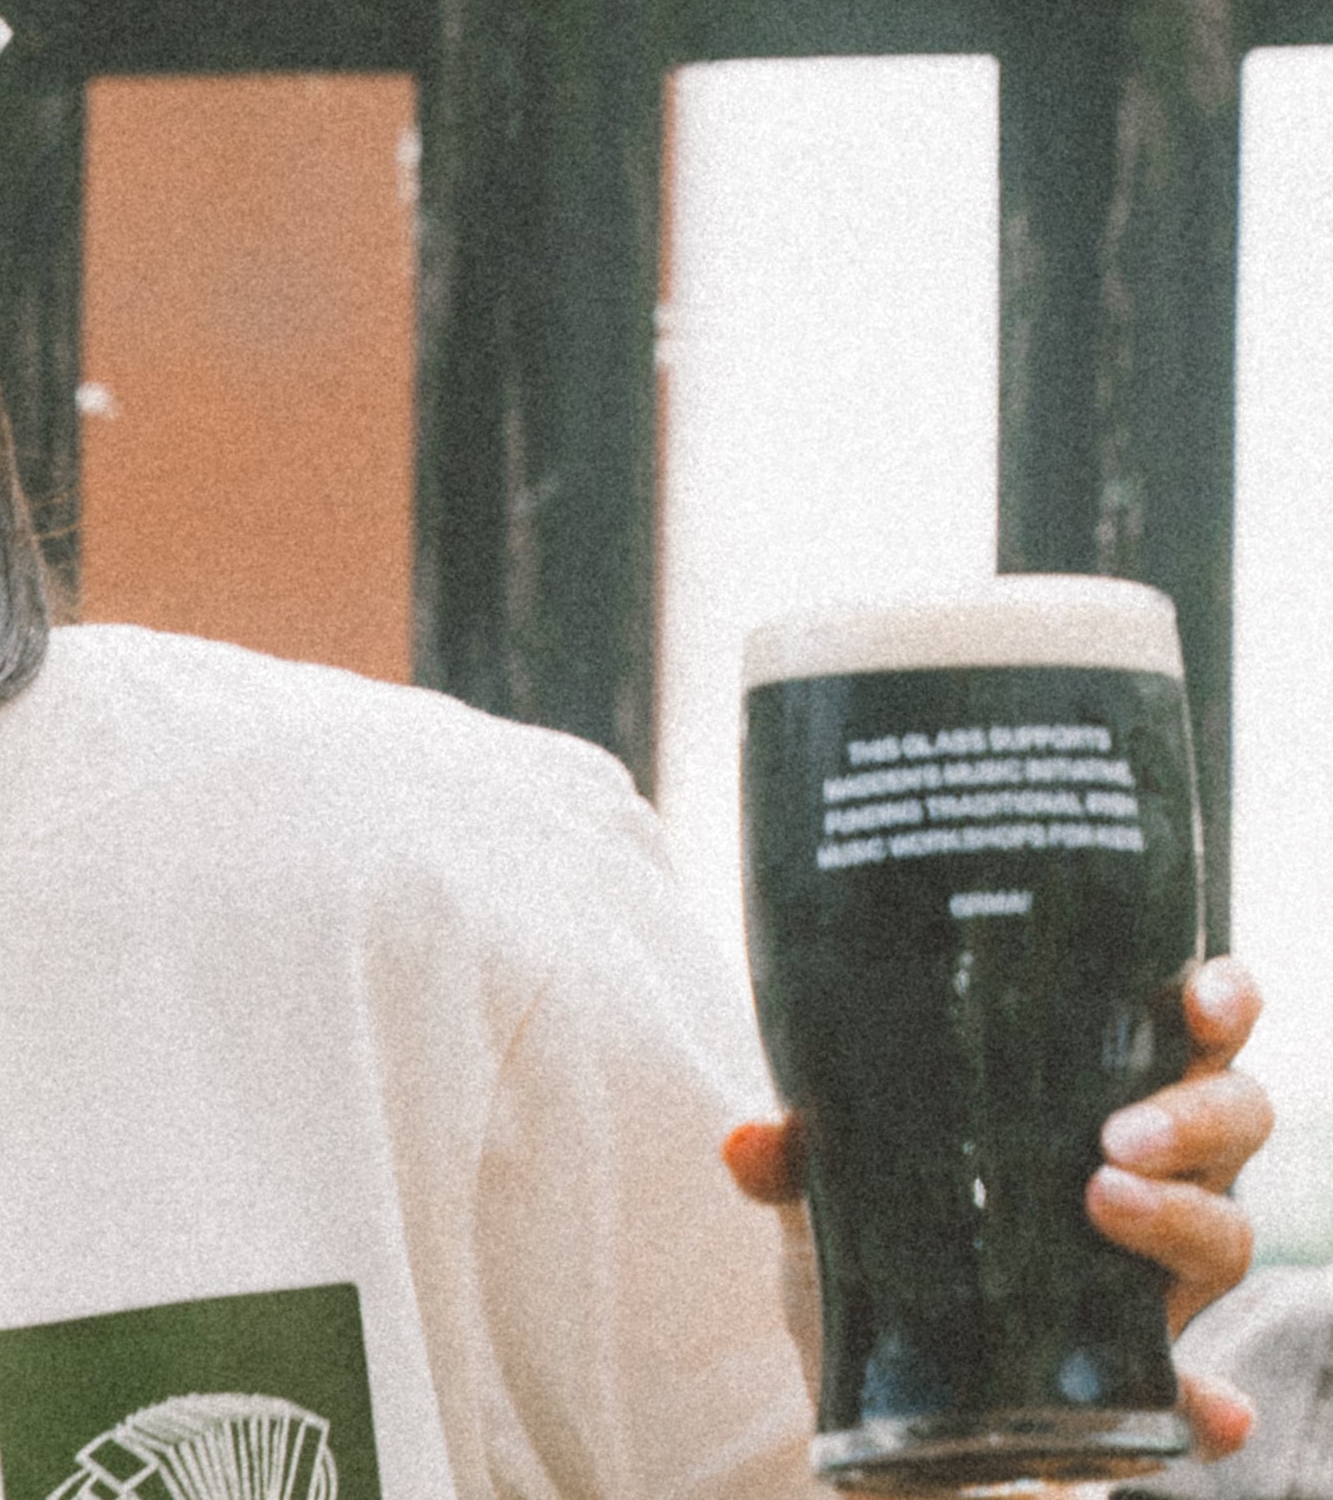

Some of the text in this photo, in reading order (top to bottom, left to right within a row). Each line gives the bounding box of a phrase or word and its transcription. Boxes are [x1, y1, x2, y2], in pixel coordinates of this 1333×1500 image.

[901, 726, 987, 760] GLASS
[988, 723, 1113, 753] SUPPORTS
[943, 758, 1023, 787] MUSIC
[926, 790, 1083, 821] TRADITIONAL
[816, 836, 888, 871] MUSIC
